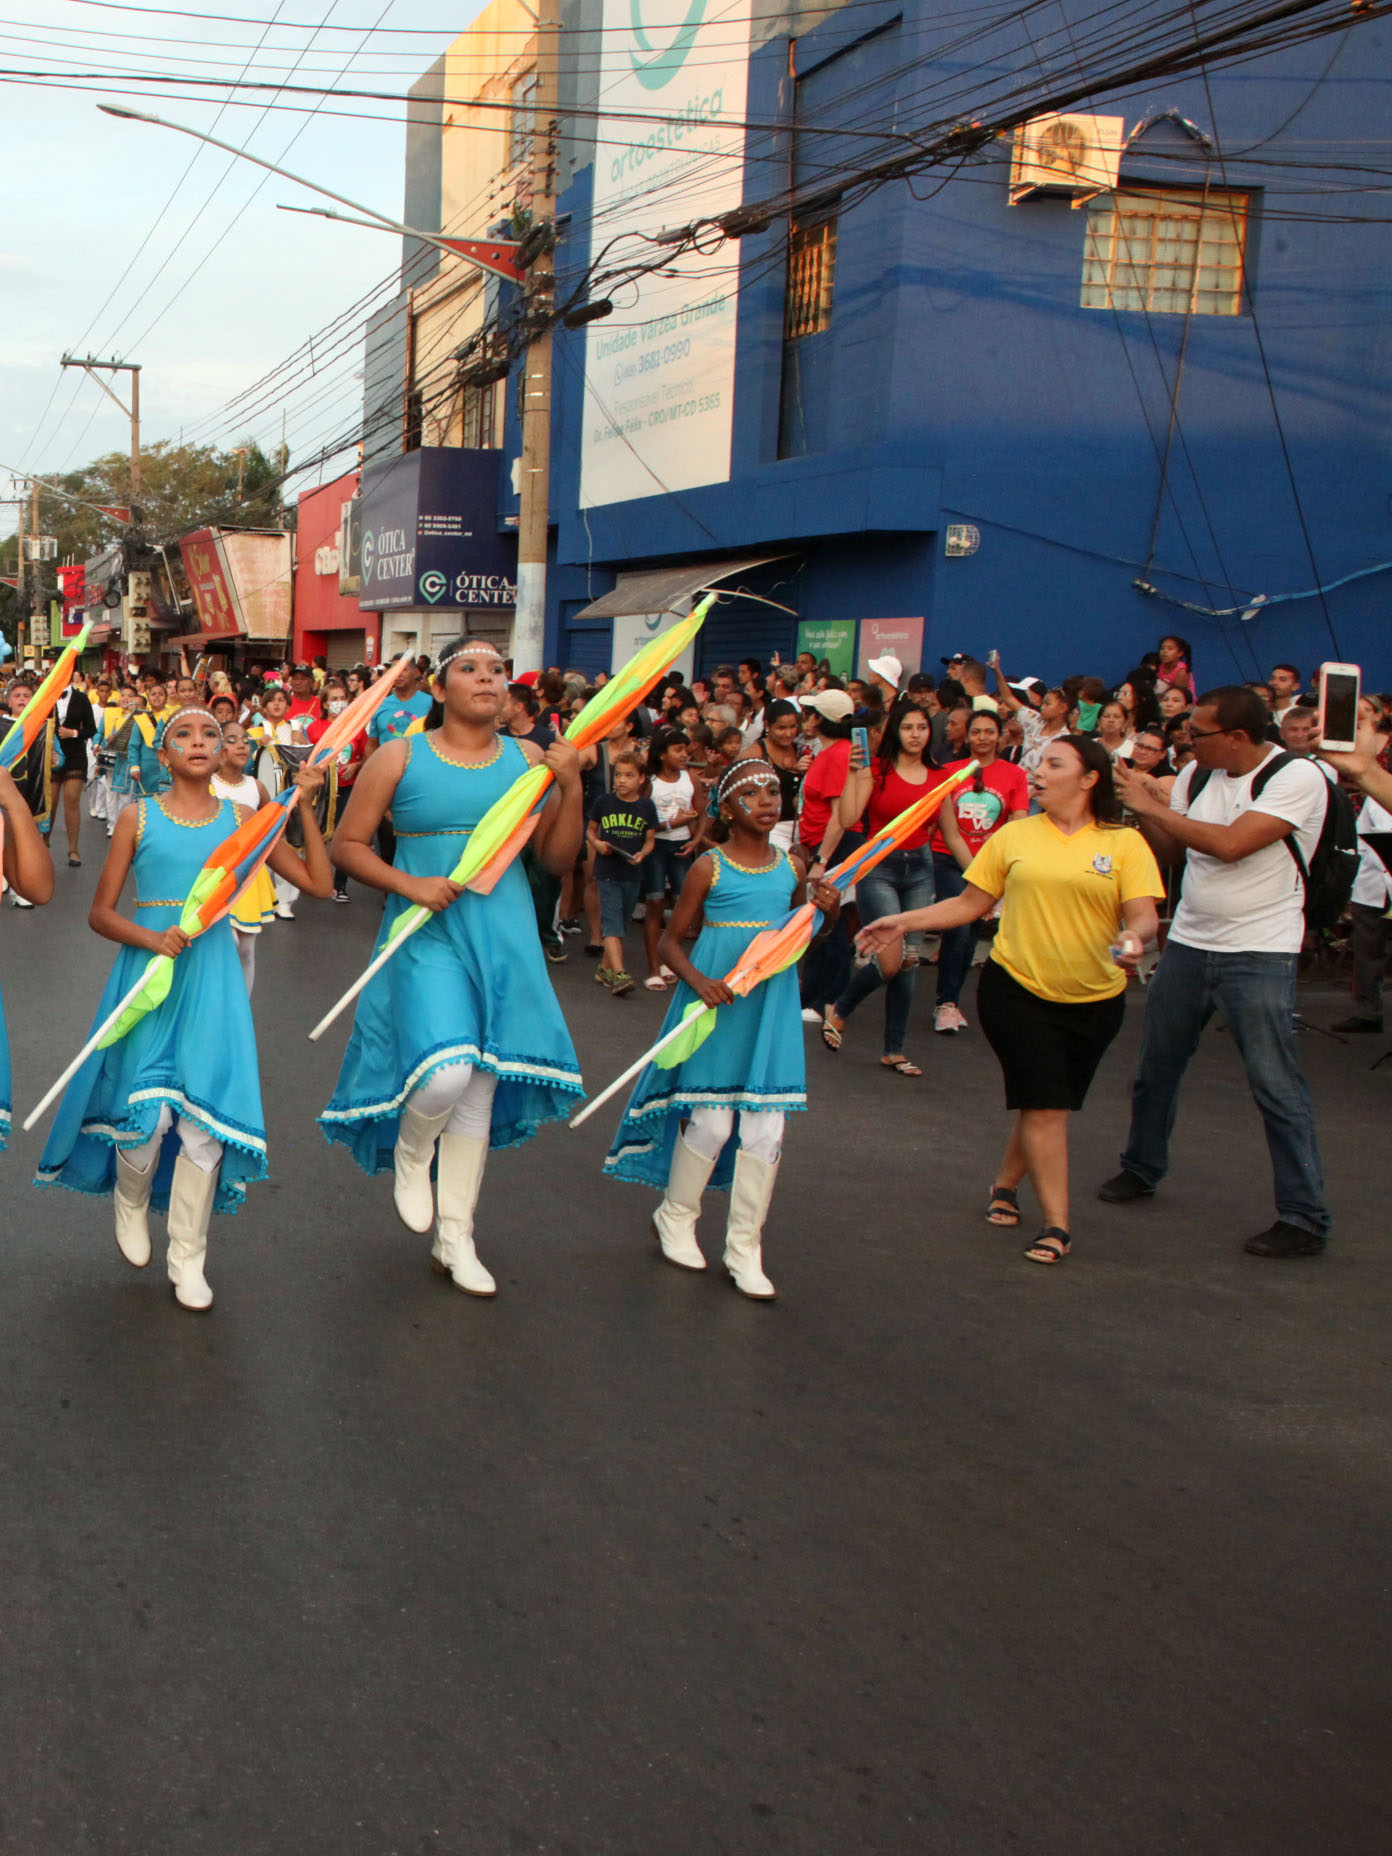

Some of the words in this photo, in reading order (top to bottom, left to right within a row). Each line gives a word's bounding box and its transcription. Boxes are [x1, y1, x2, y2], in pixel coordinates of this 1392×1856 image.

[596, 327, 638, 360] Unidade
[680, 292, 726, 326] Grande
[378, 526, 406, 555] ÓTICA
[377, 553, 413, 580] CENTER
[456, 571, 510, 589] ÓTICA
[972, 817, 993, 831] VG
